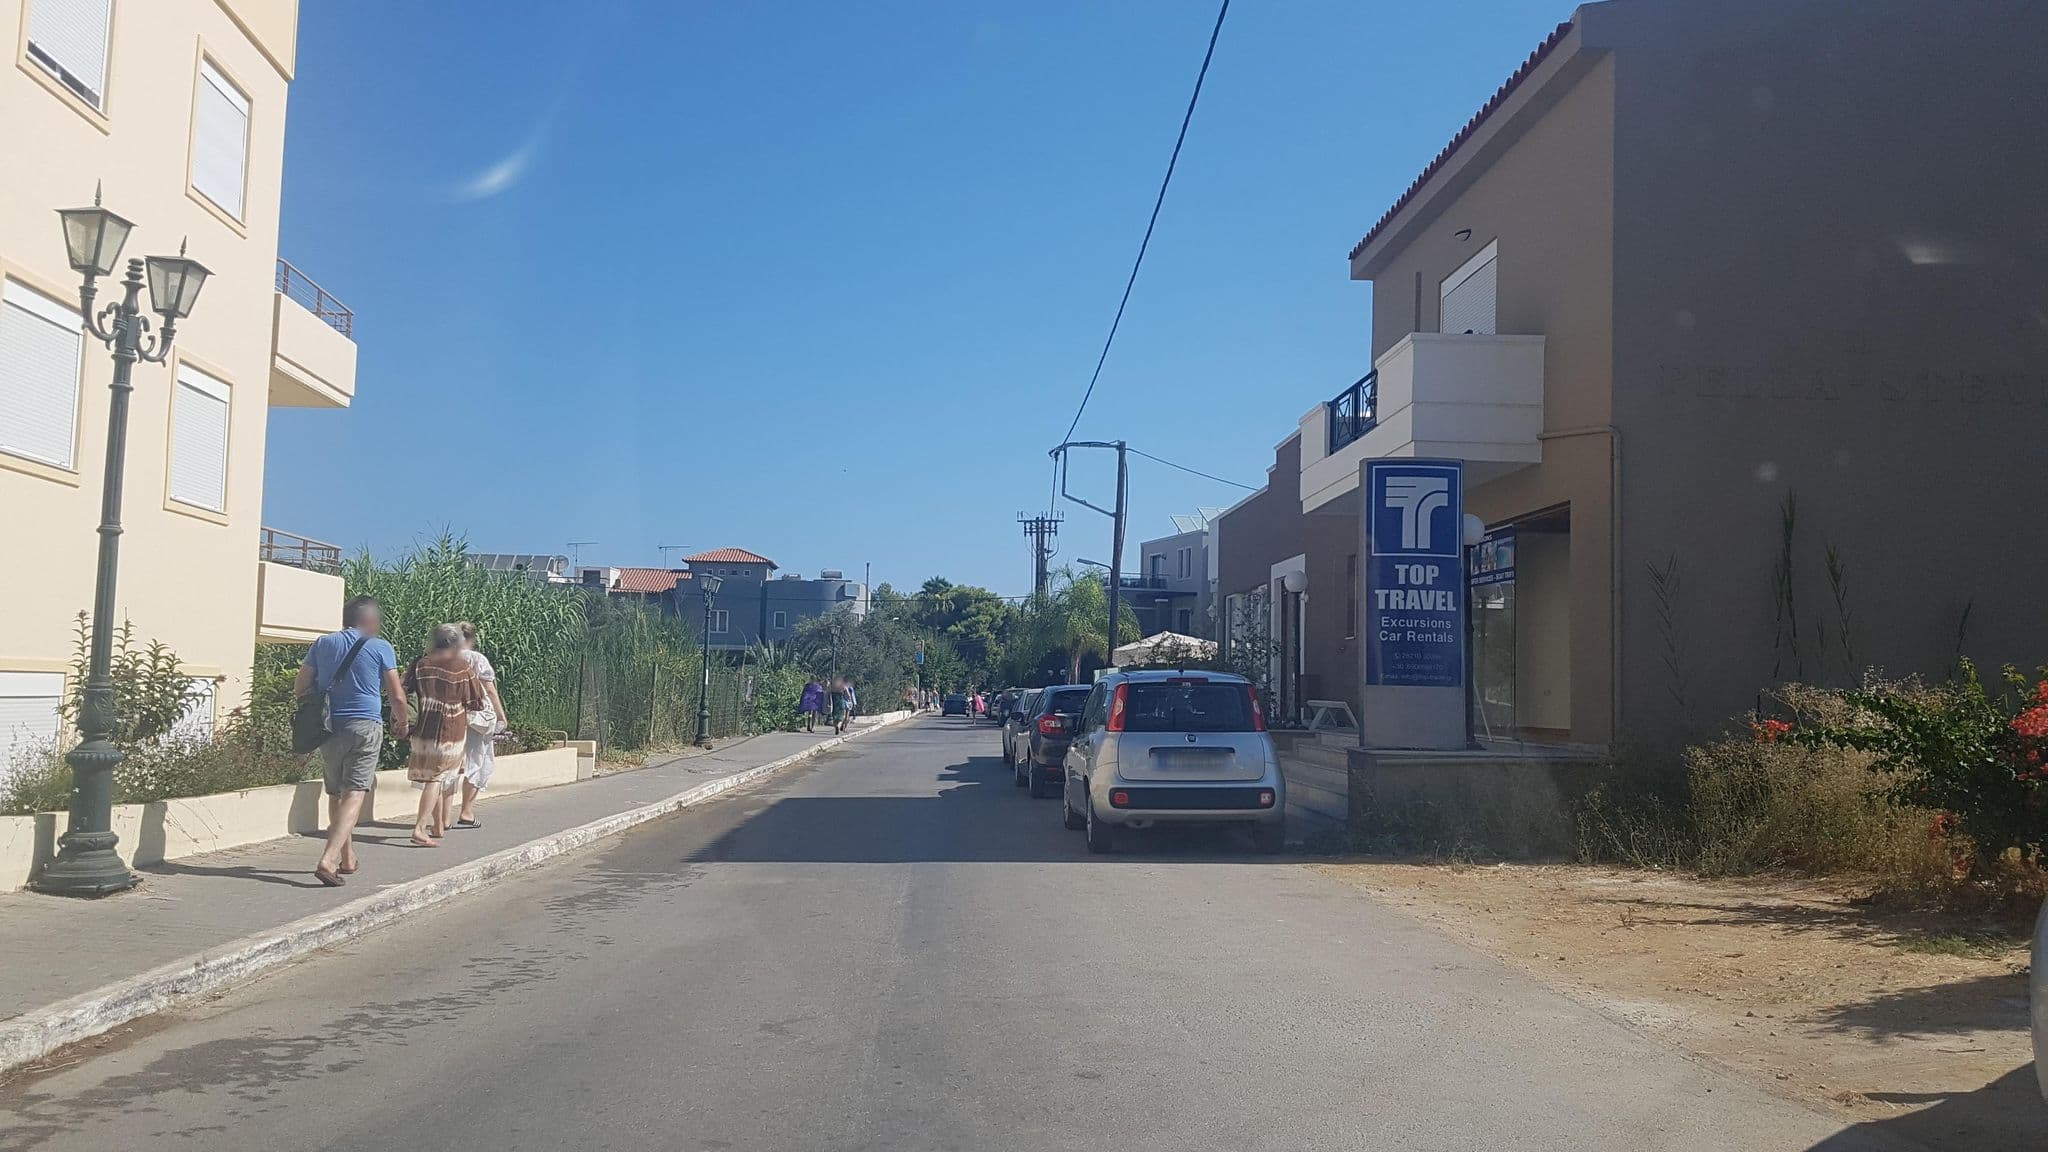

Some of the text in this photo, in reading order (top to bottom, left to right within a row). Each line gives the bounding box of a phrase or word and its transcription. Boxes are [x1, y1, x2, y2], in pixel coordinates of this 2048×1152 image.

[1395, 564, 1440, 585] TOP
[1375, 589, 1457, 611] TRAVEL
[1381, 616, 1452, 629] Excursions
[1380, 630, 1454, 643] Car Rentals
